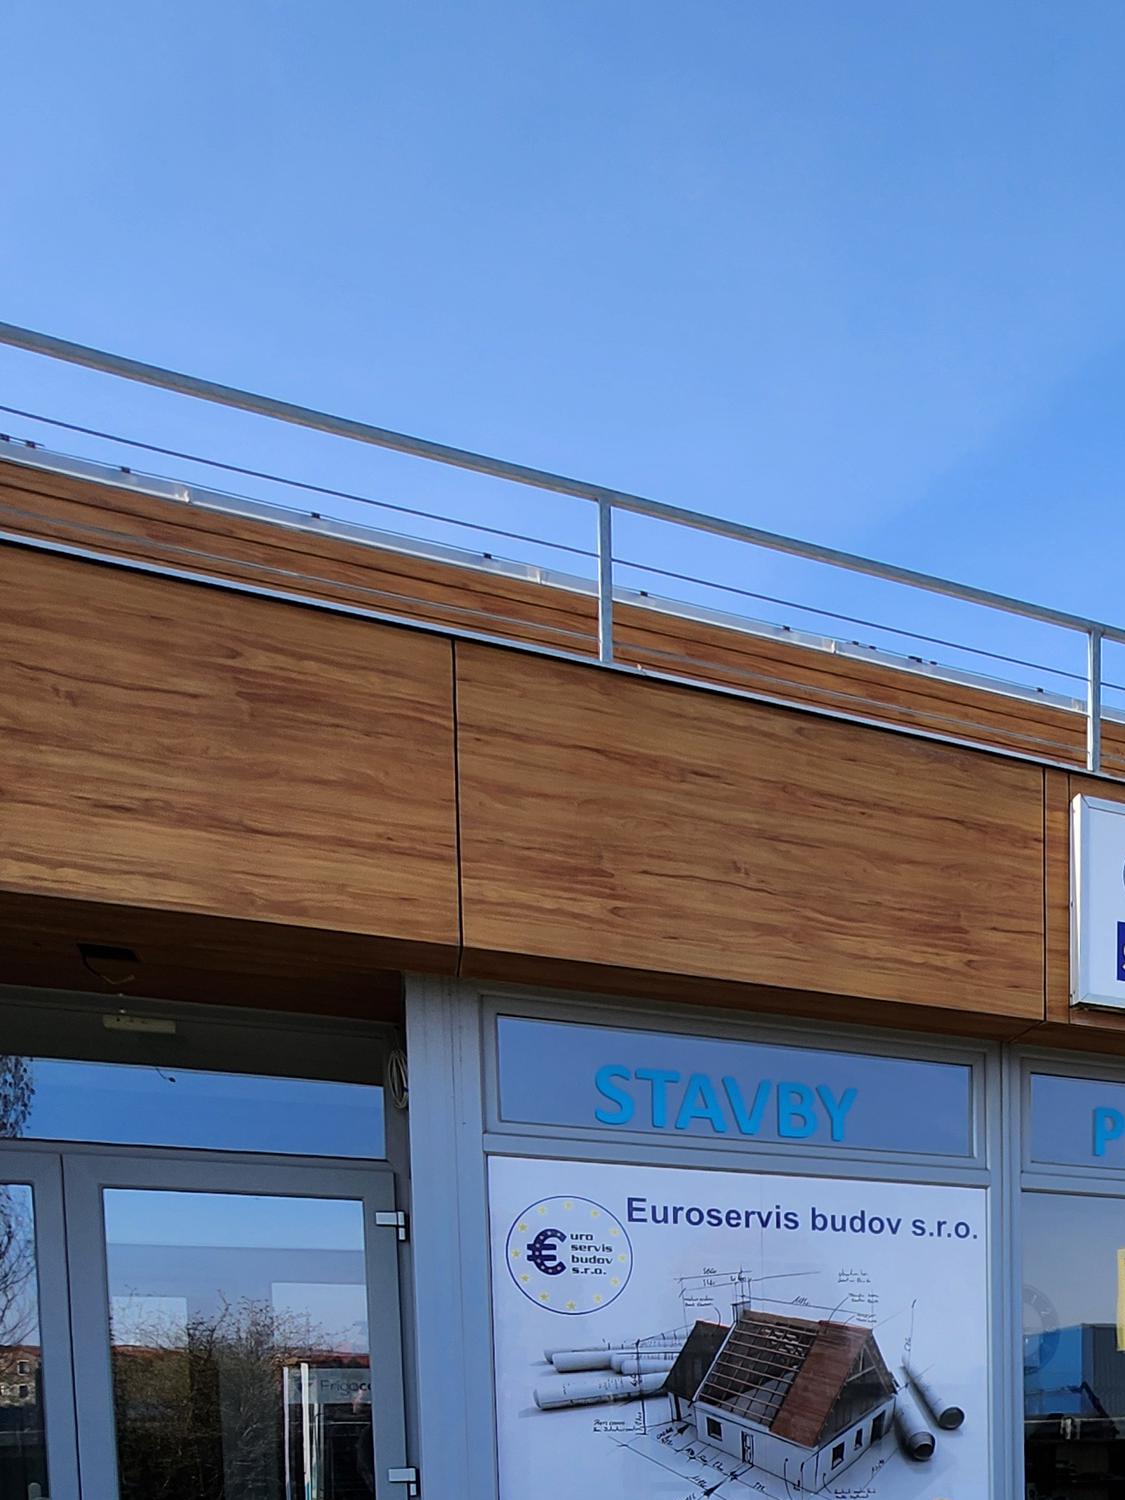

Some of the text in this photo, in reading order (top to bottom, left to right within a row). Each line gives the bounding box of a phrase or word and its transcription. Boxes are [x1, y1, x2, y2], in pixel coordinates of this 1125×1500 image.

[594, 1064, 858, 1142] STAVBY
[627, 1197, 979, 1241] Euroservis budov s.r.o.
[571, 1244, 613, 1253] servis
[571, 1255, 613, 1265] budov
[572, 1267, 607, 1275] s.r.o.
